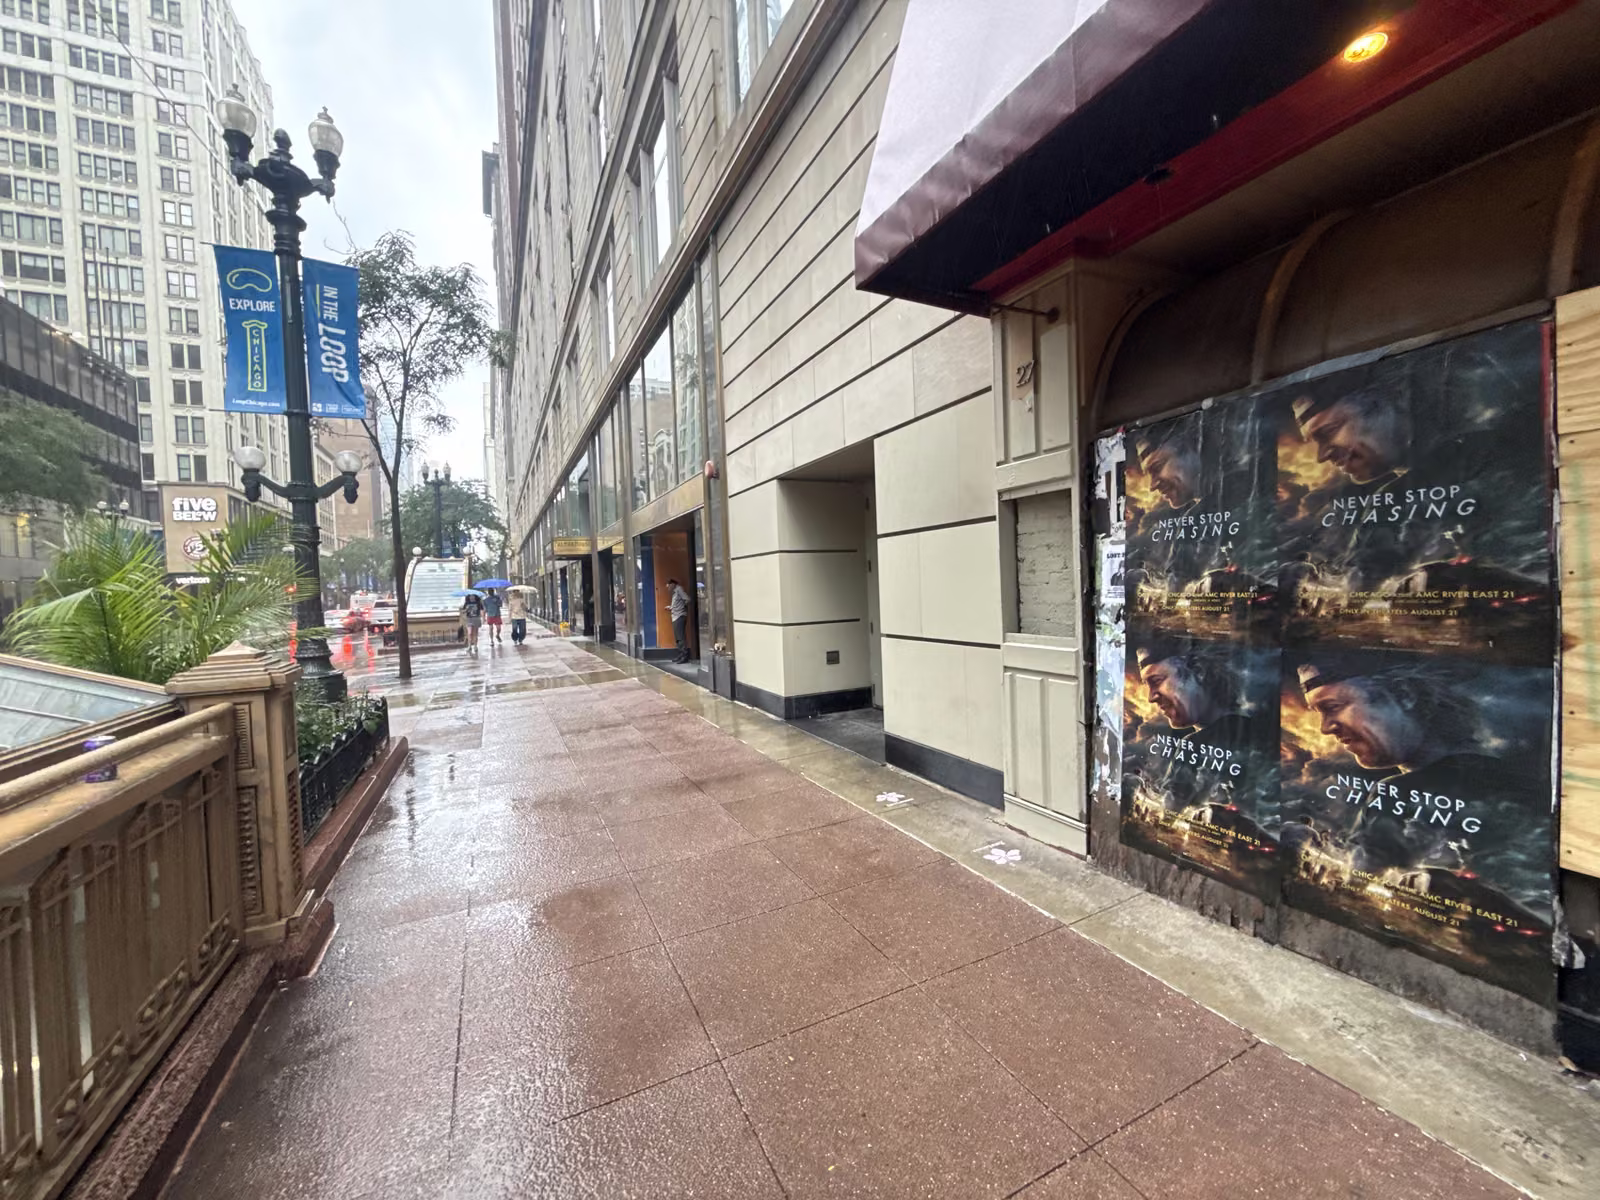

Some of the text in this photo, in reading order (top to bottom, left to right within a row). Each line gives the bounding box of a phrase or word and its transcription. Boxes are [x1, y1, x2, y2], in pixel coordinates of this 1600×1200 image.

[229, 298, 276, 312] EXPLORE
[318, 285, 349, 383] IN THE LOOP
[252, 328, 262, 389] CHICAGO
[1015, 360, 1035, 389] 27
[172, 497, 217, 511] five
[1333, 485, 1460, 510] NEVER STOP
[172, 511, 217, 521] BELOW
[1158, 511, 1231, 529] NEVER STOP
[1321, 498, 1477, 528] CHASING
[1151, 522, 1240, 542] CHASING
[175, 576, 210, 584] verizon
[1205, 591, 1218, 599] AMC
[1237, 591, 1250, 599] EAST
[1149, 743, 1241, 776] CHASING
[1157, 734, 1232, 760] NEVER STOP
[1337, 773, 1465, 812] NEVER STOP
[1325, 785, 1482, 833] CHASING
[1205, 822, 1218, 832] AMC
[1219, 826, 1236, 838] RIVER
[1237, 833, 1253, 843] EAST
[1413, 905, 1448, 922] AUGUST
[1449, 918, 1460, 927] 21
[1420, 889, 1442, 904] AMC
[1444, 898, 1473, 913] RIVER
[1476, 908, 1503, 922] EAST
[1505, 917, 1518, 928] 21
